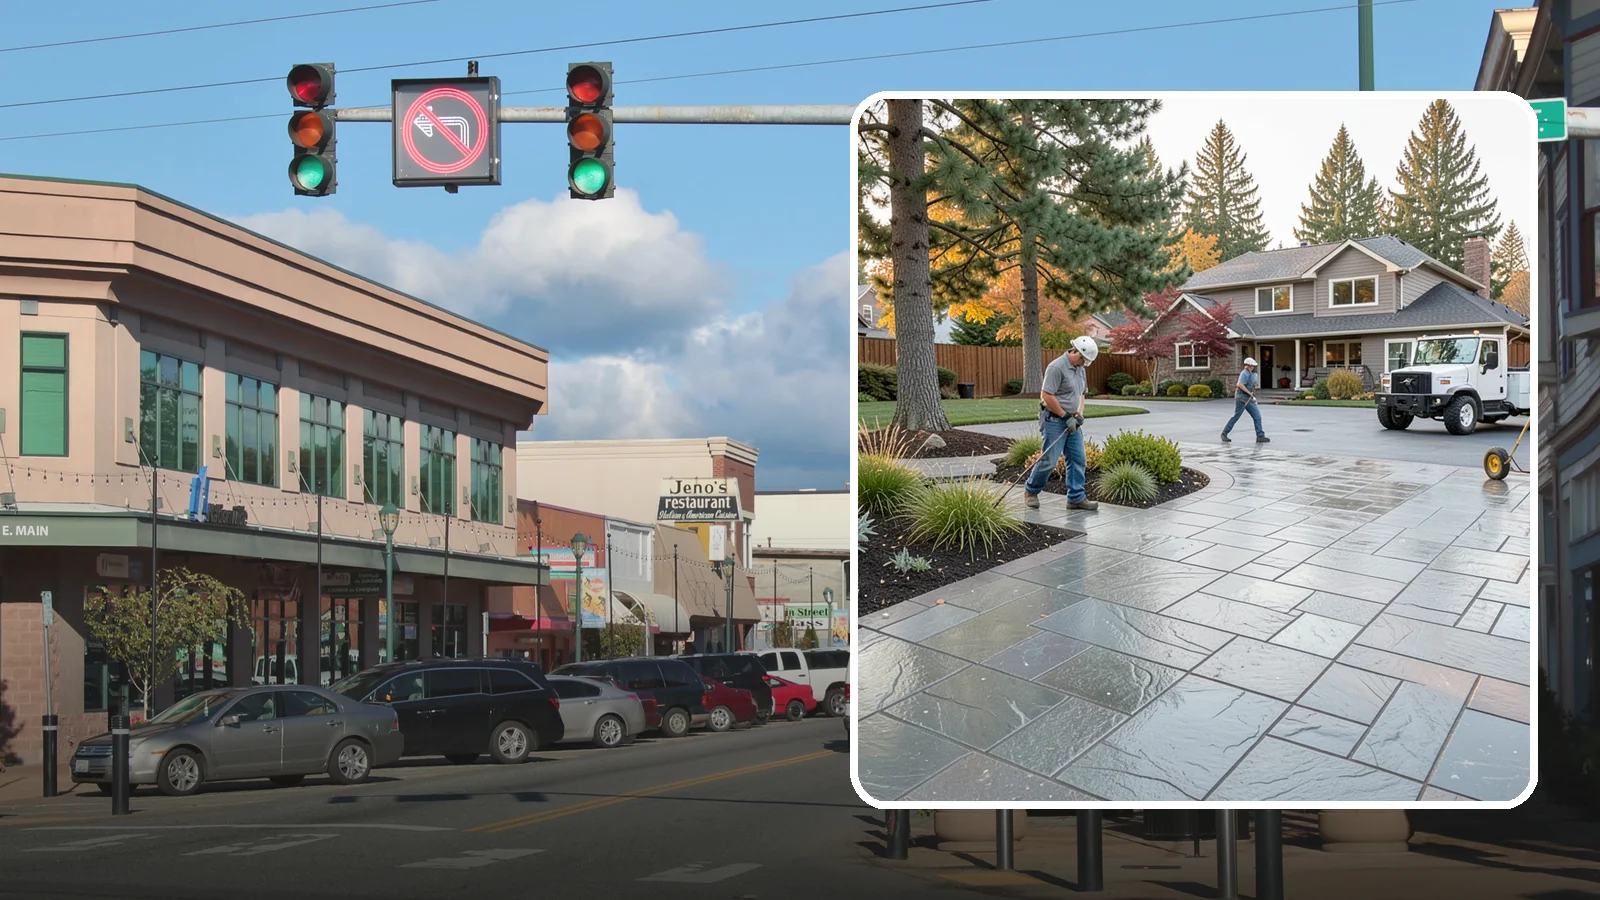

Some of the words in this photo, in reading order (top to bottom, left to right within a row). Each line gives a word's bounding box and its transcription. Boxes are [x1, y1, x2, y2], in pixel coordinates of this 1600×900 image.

[669, 479, 728, 494] Jeno's
[664, 496, 731, 509] restaurant
[658, 509, 681, 520] Italian
[686, 509, 714, 519] American
[715, 509, 738, 519] Cuisine
[2, 525, 13, 536] E.
[15, 525, 49, 537] MAIN
[797, 607, 828, 616] Street
[790, 619, 823, 627] lass
